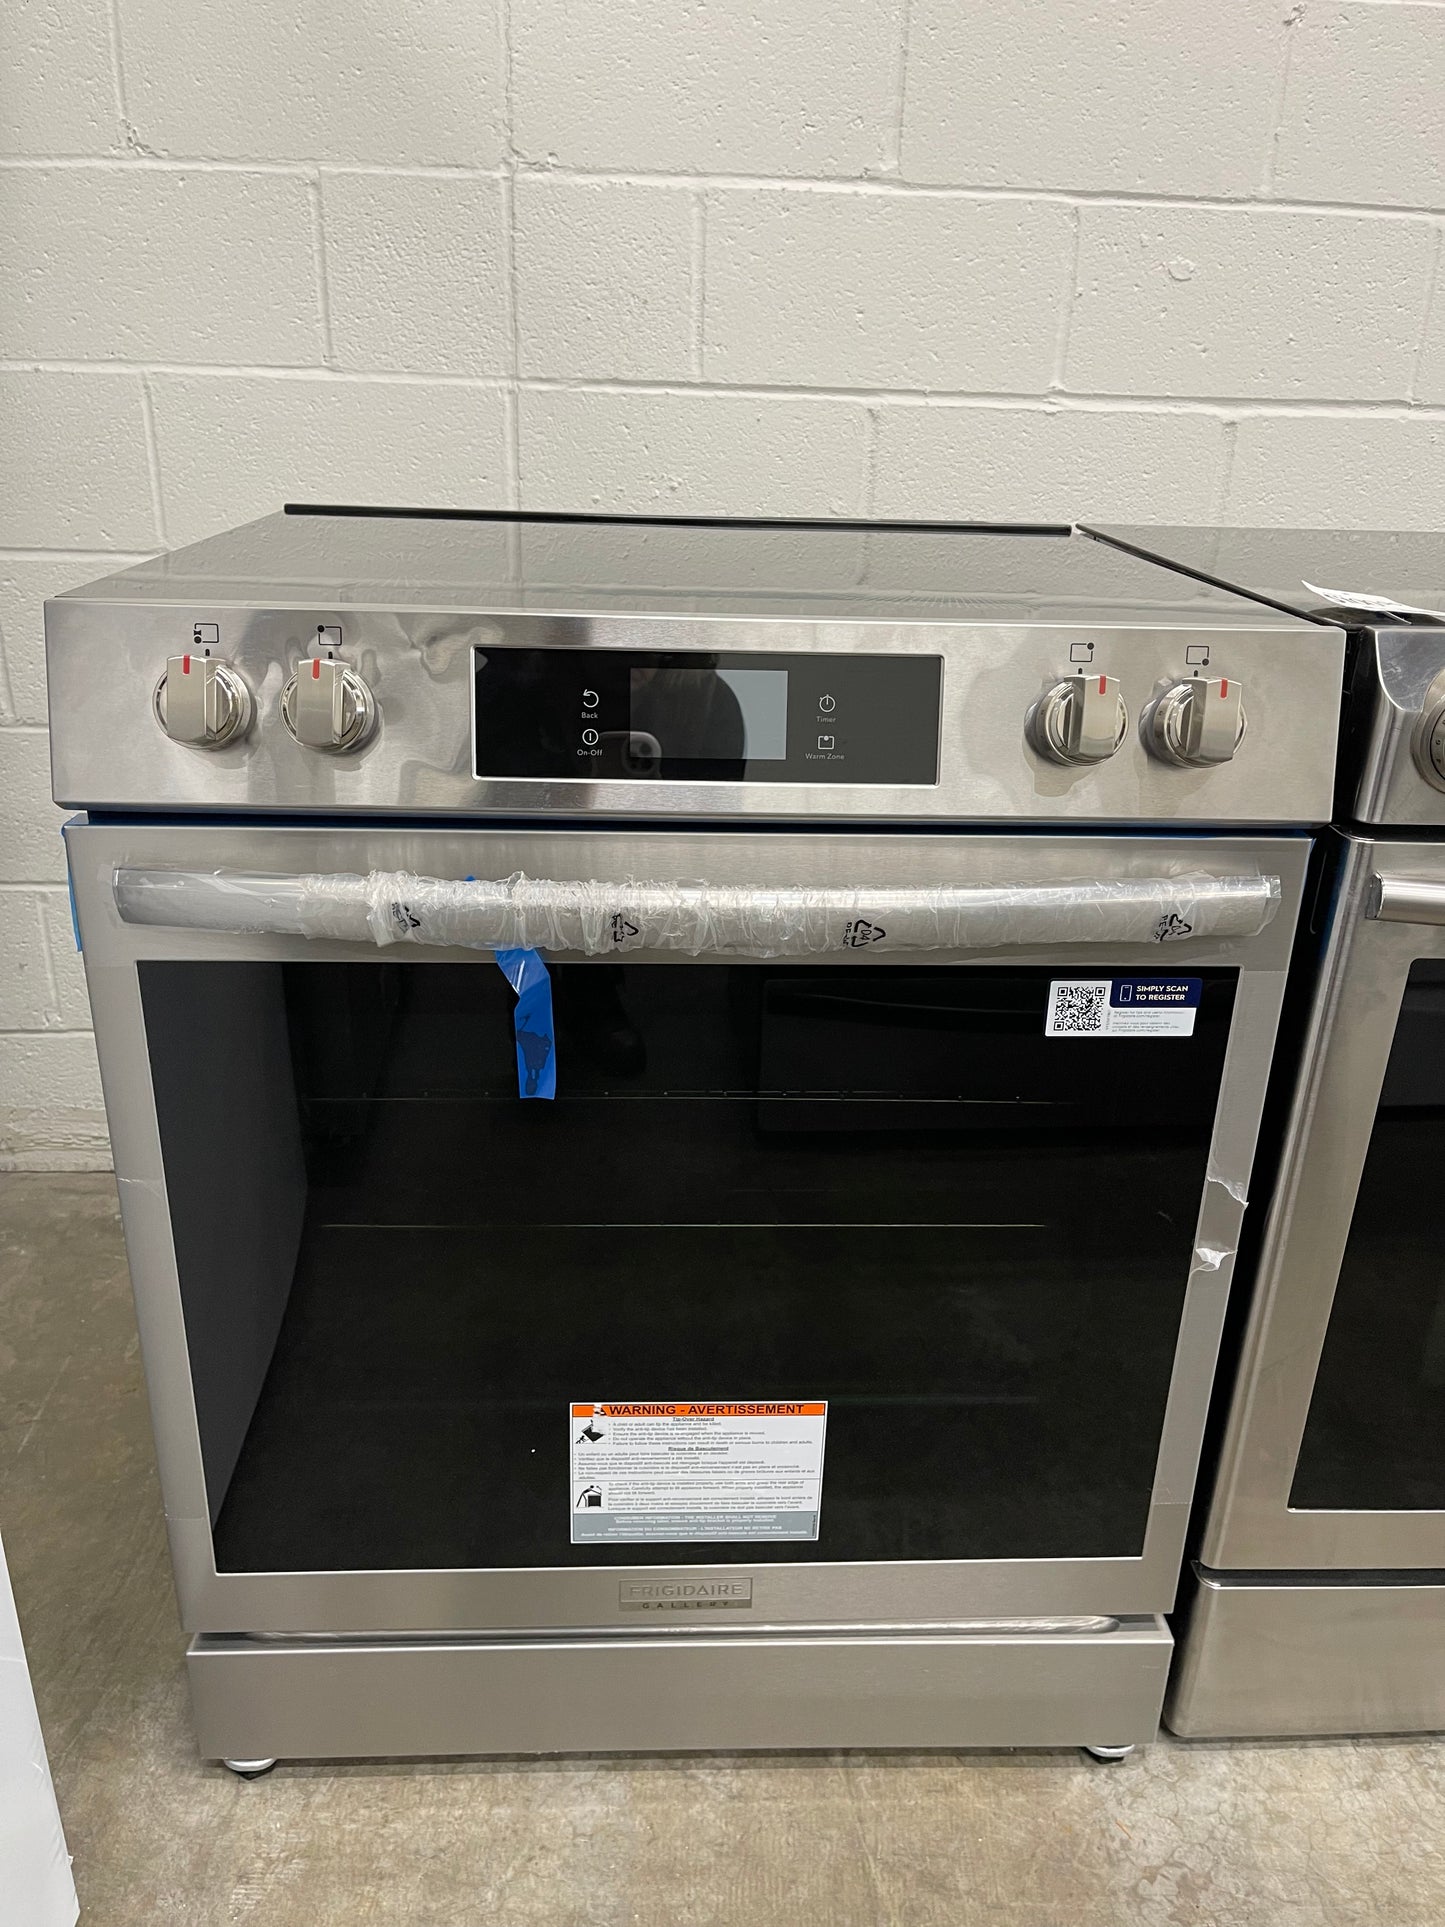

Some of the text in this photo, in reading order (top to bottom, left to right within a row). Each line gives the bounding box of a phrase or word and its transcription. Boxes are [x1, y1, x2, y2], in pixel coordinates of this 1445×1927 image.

[610, 1406, 676, 1415] WARNING
[688, 1405, 804, 1414] AVERTISSEMENT
[630, 1583, 743, 1596] FRIGIDAIRE
